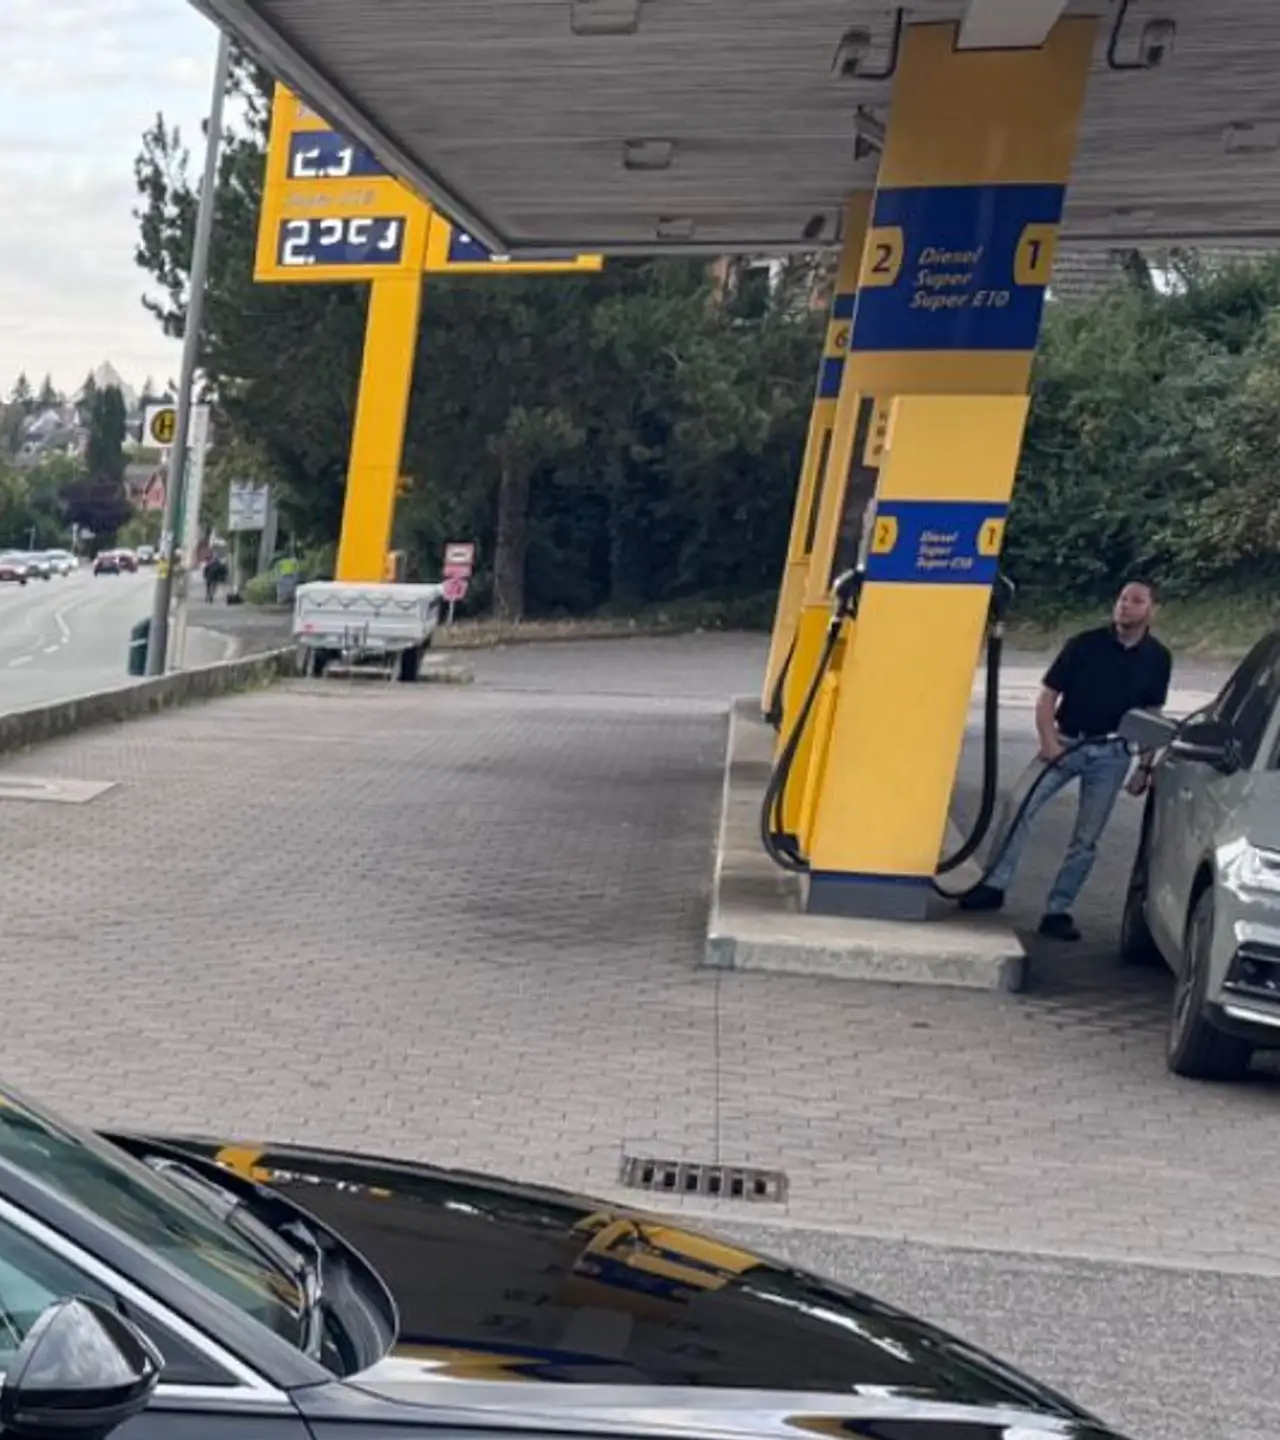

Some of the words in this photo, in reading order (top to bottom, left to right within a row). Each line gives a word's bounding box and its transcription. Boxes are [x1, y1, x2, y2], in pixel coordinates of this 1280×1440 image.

[872, 244, 894, 273] 2
[918, 246, 984, 265] Diesel
[1026, 240, 1042, 270] 1
[915, 268, 973, 291] Super
[907, 290, 969, 312] Super
[971, 290, 1011, 308] E10
[878, 523, 890, 546] 2
[987, 525, 997, 546] 1
